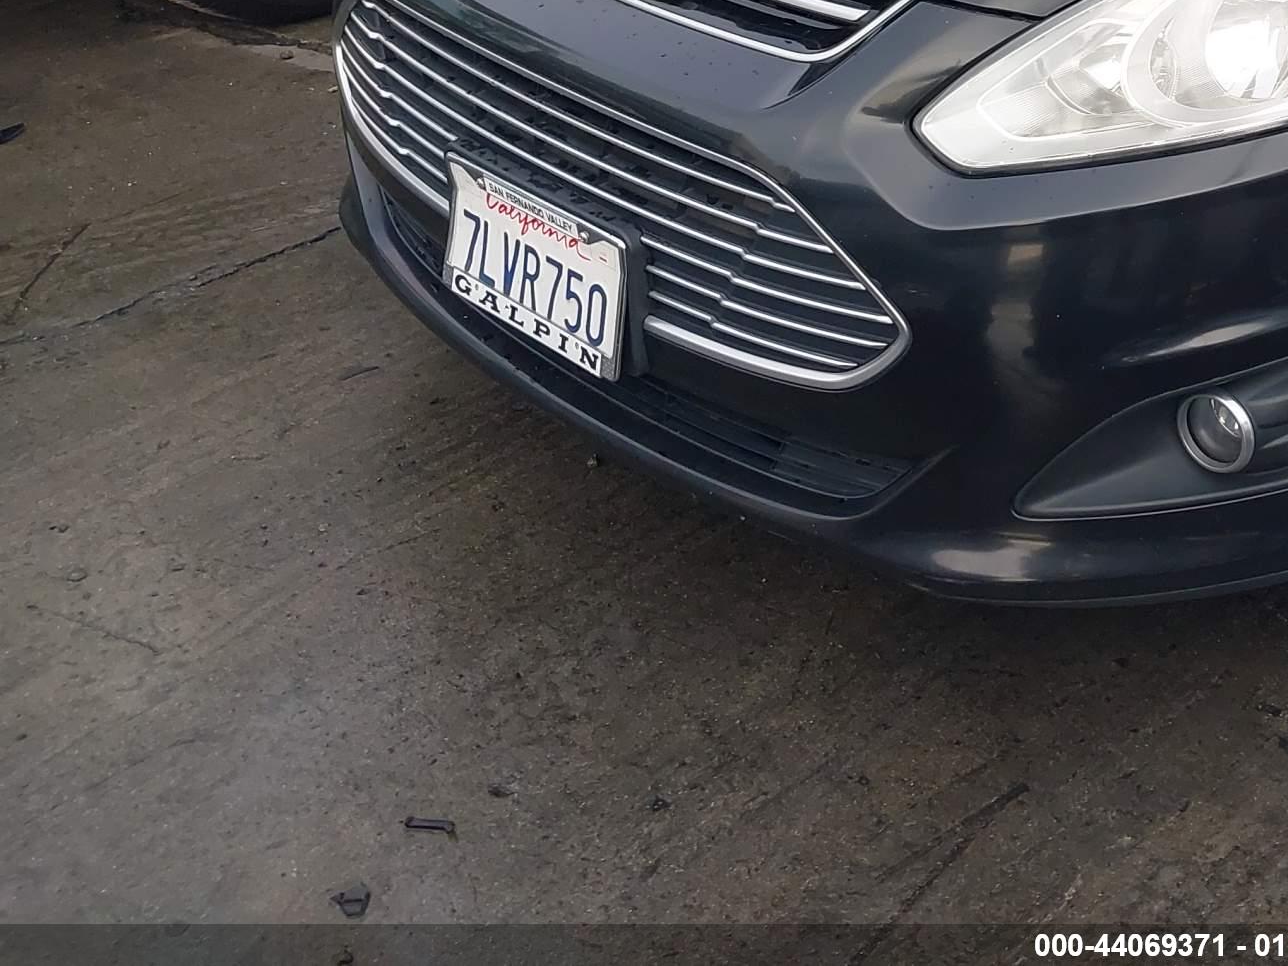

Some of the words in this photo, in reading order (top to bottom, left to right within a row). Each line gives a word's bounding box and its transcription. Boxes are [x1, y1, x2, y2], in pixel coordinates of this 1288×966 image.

[488, 183, 504, 198] SAN
[506, 192, 545, 219] FERNANDO
[545, 210, 573, 233] VALLEY
[454, 273, 600, 371] GALPIN
[463, 208, 608, 348] 7LVR750
